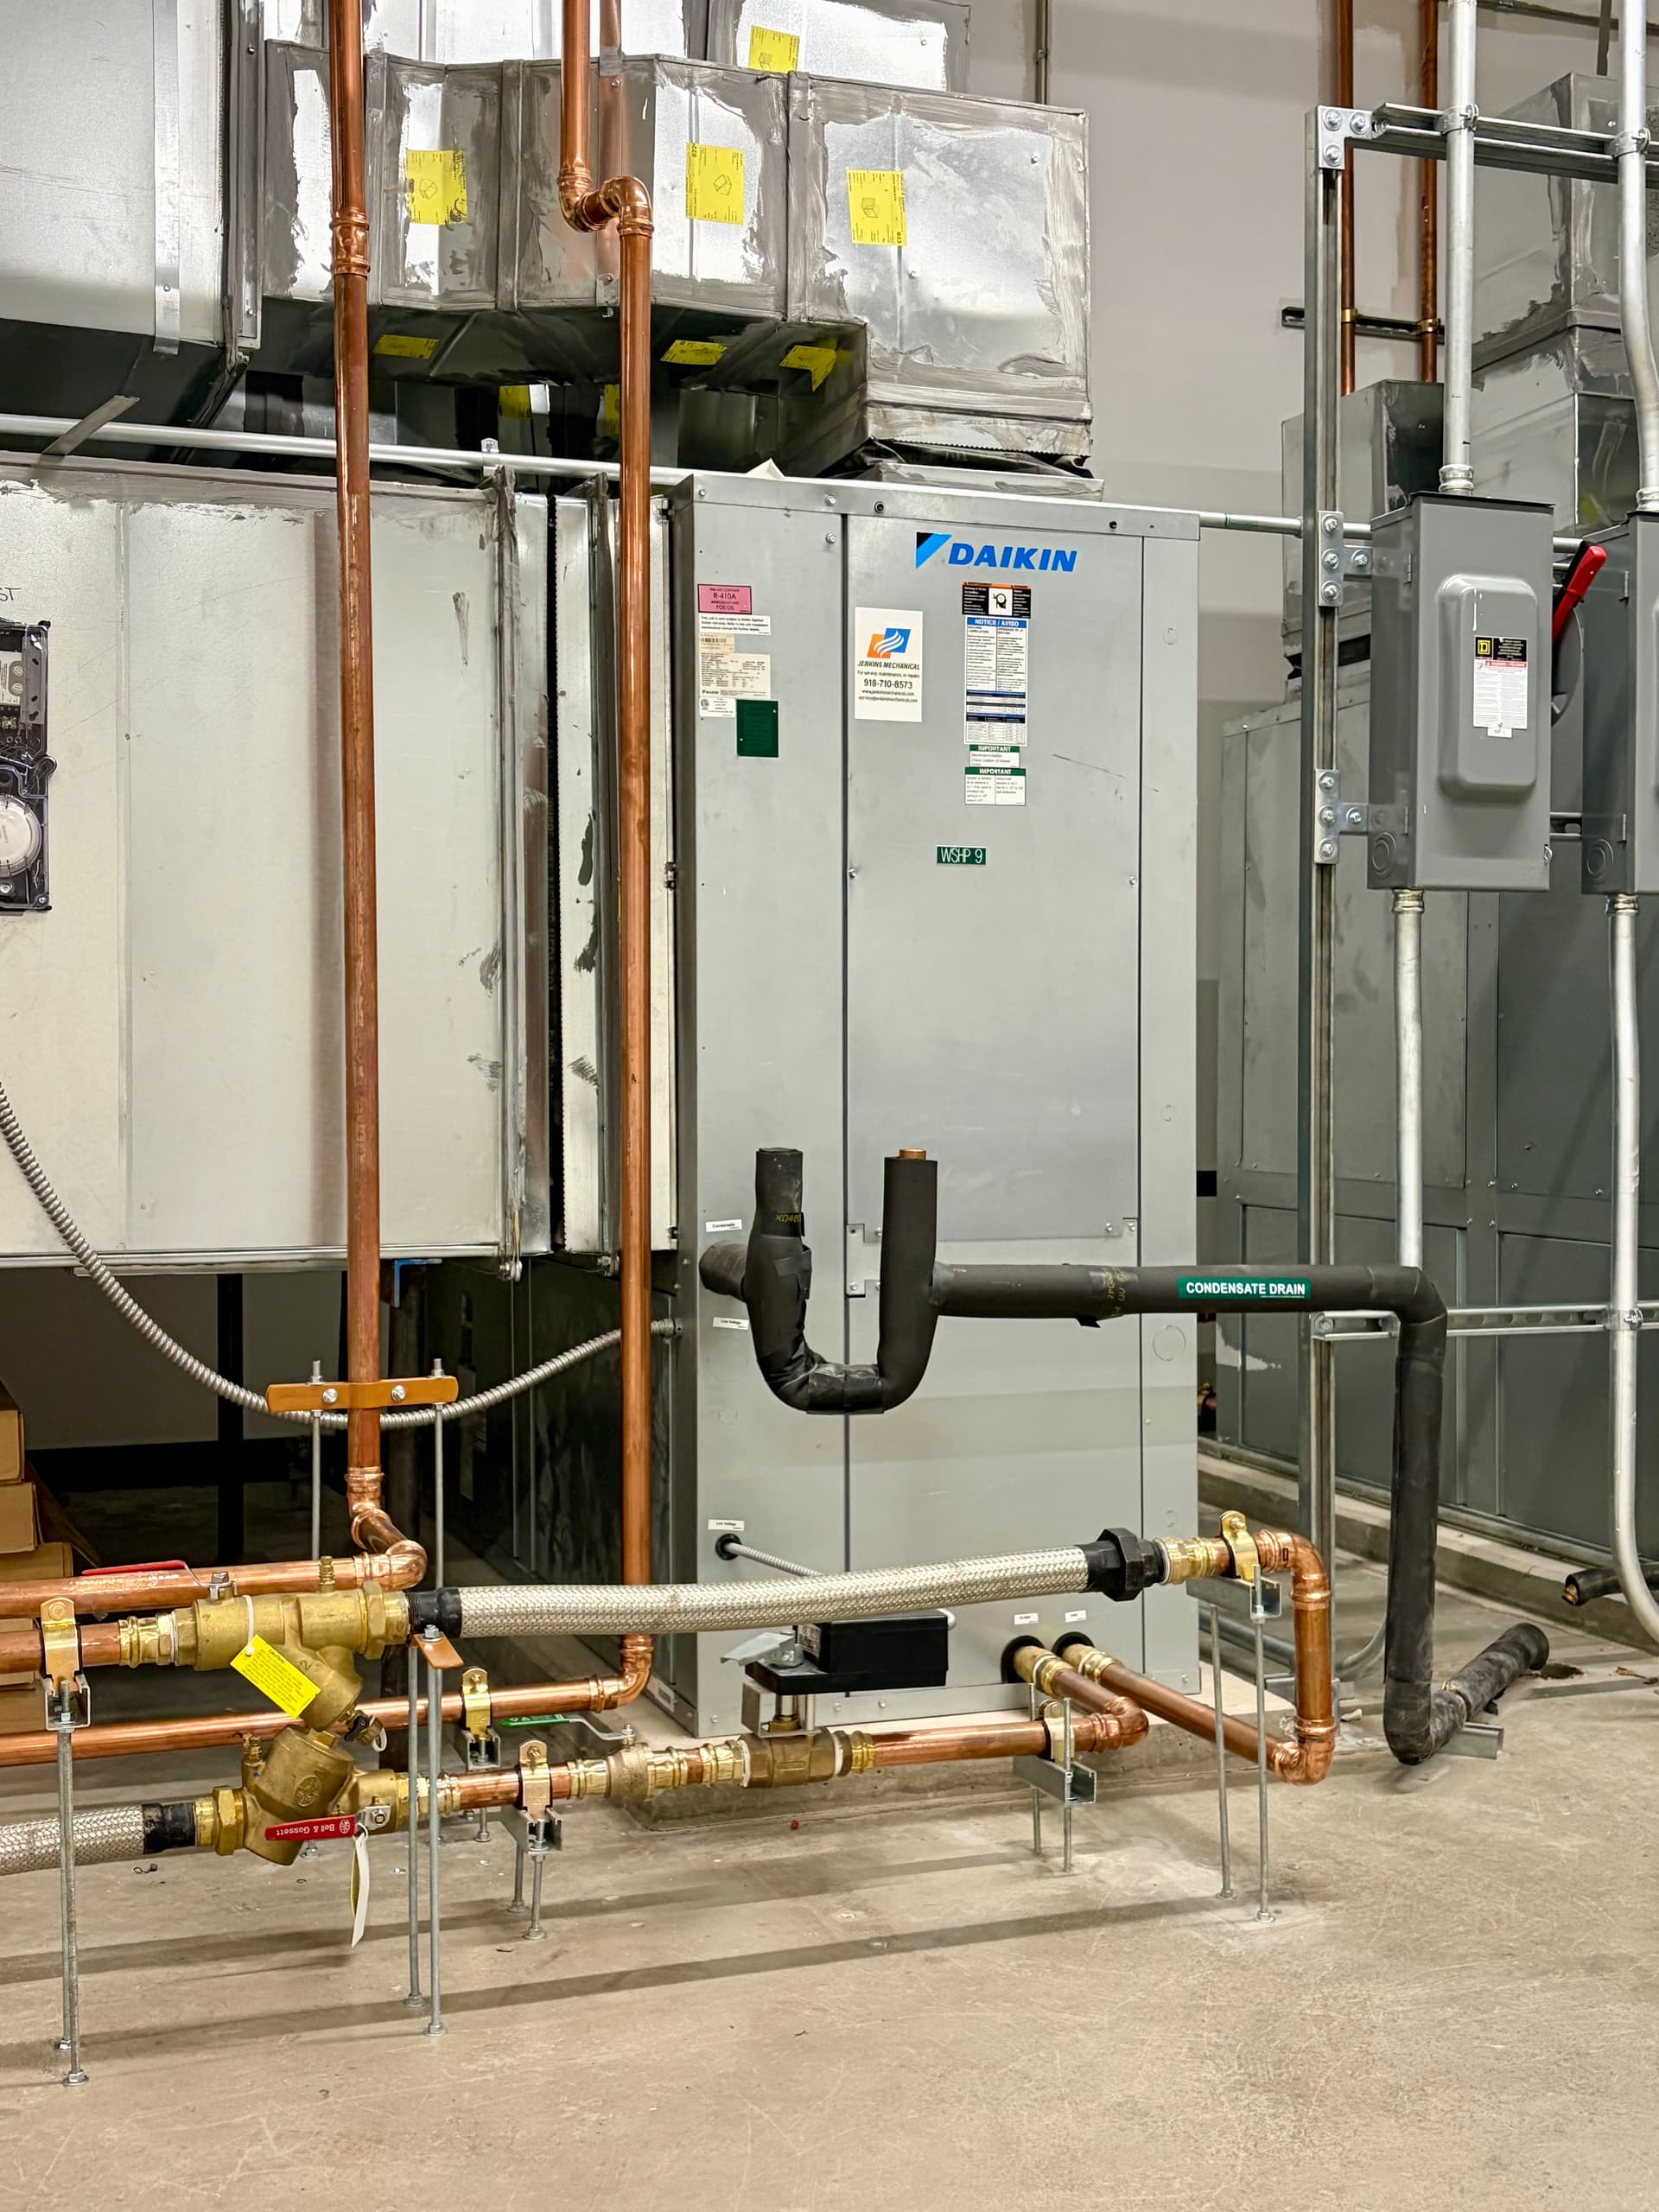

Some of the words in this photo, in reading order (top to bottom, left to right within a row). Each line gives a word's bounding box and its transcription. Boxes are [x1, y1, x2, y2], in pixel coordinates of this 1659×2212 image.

[948, 543, 1077, 572] DAIKIN
[883, 662, 920, 671] MECHANICAL
[864, 678, 913, 690] 918-710-8573
[941, 847, 971, 863] WSHP
[975, 849, 983, 864] 9
[1185, 1281, 1266, 1294] CONDENSATE
[1268, 1282, 1306, 1295] DRAIN
[276, 1826, 310, 1836] Gossett
[313, 1825, 320, 1834] &
[321, 1823, 335, 1833] Bell
